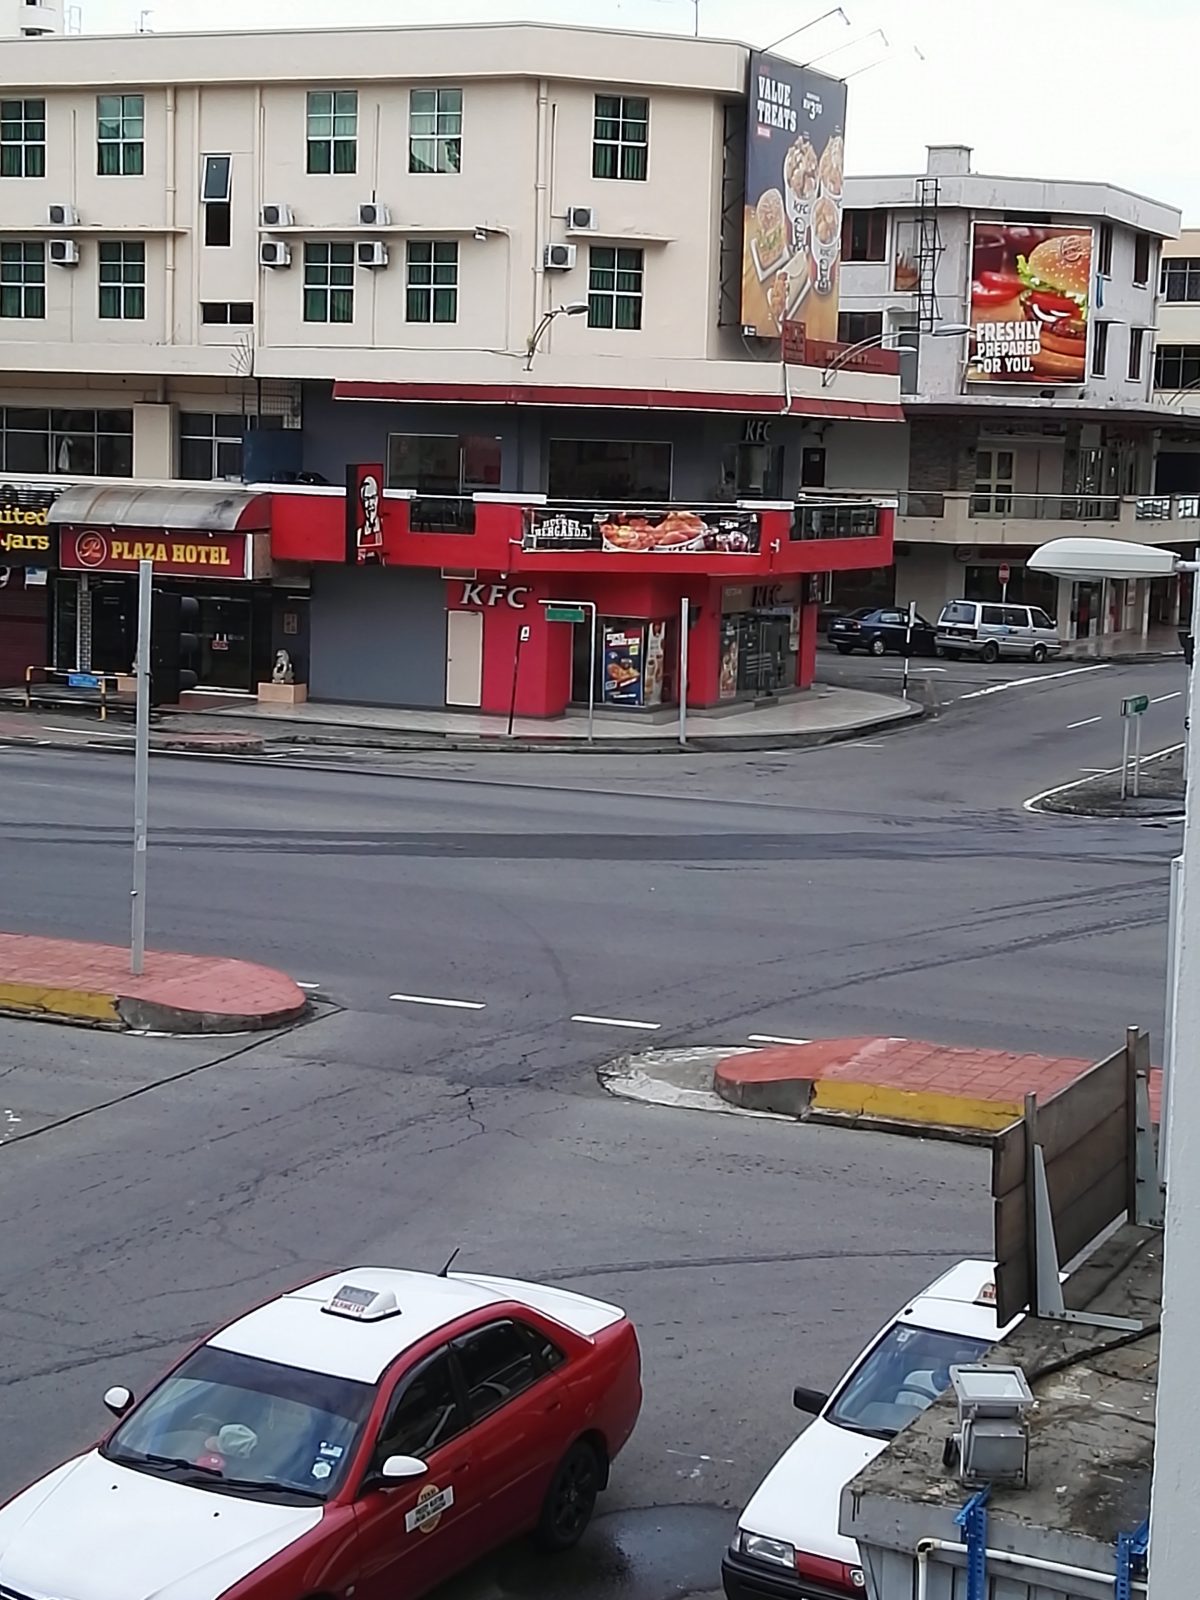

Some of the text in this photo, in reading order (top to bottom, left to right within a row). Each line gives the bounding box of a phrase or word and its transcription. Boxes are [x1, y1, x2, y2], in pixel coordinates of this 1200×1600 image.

[758, 75, 791, 107] VALUE
[757, 99, 797, 133] TREATS
[976, 320, 1043, 342] FRESHLY
[977, 340, 1041, 359] PREPARED
[1004, 357, 1035, 373] YOU.
[745, 420, 772, 441] KFC
[111, 541, 231, 566] PLAZA HOTEL
[459, 582, 528, 609] KFC
[752, 584, 784, 607] KFC
